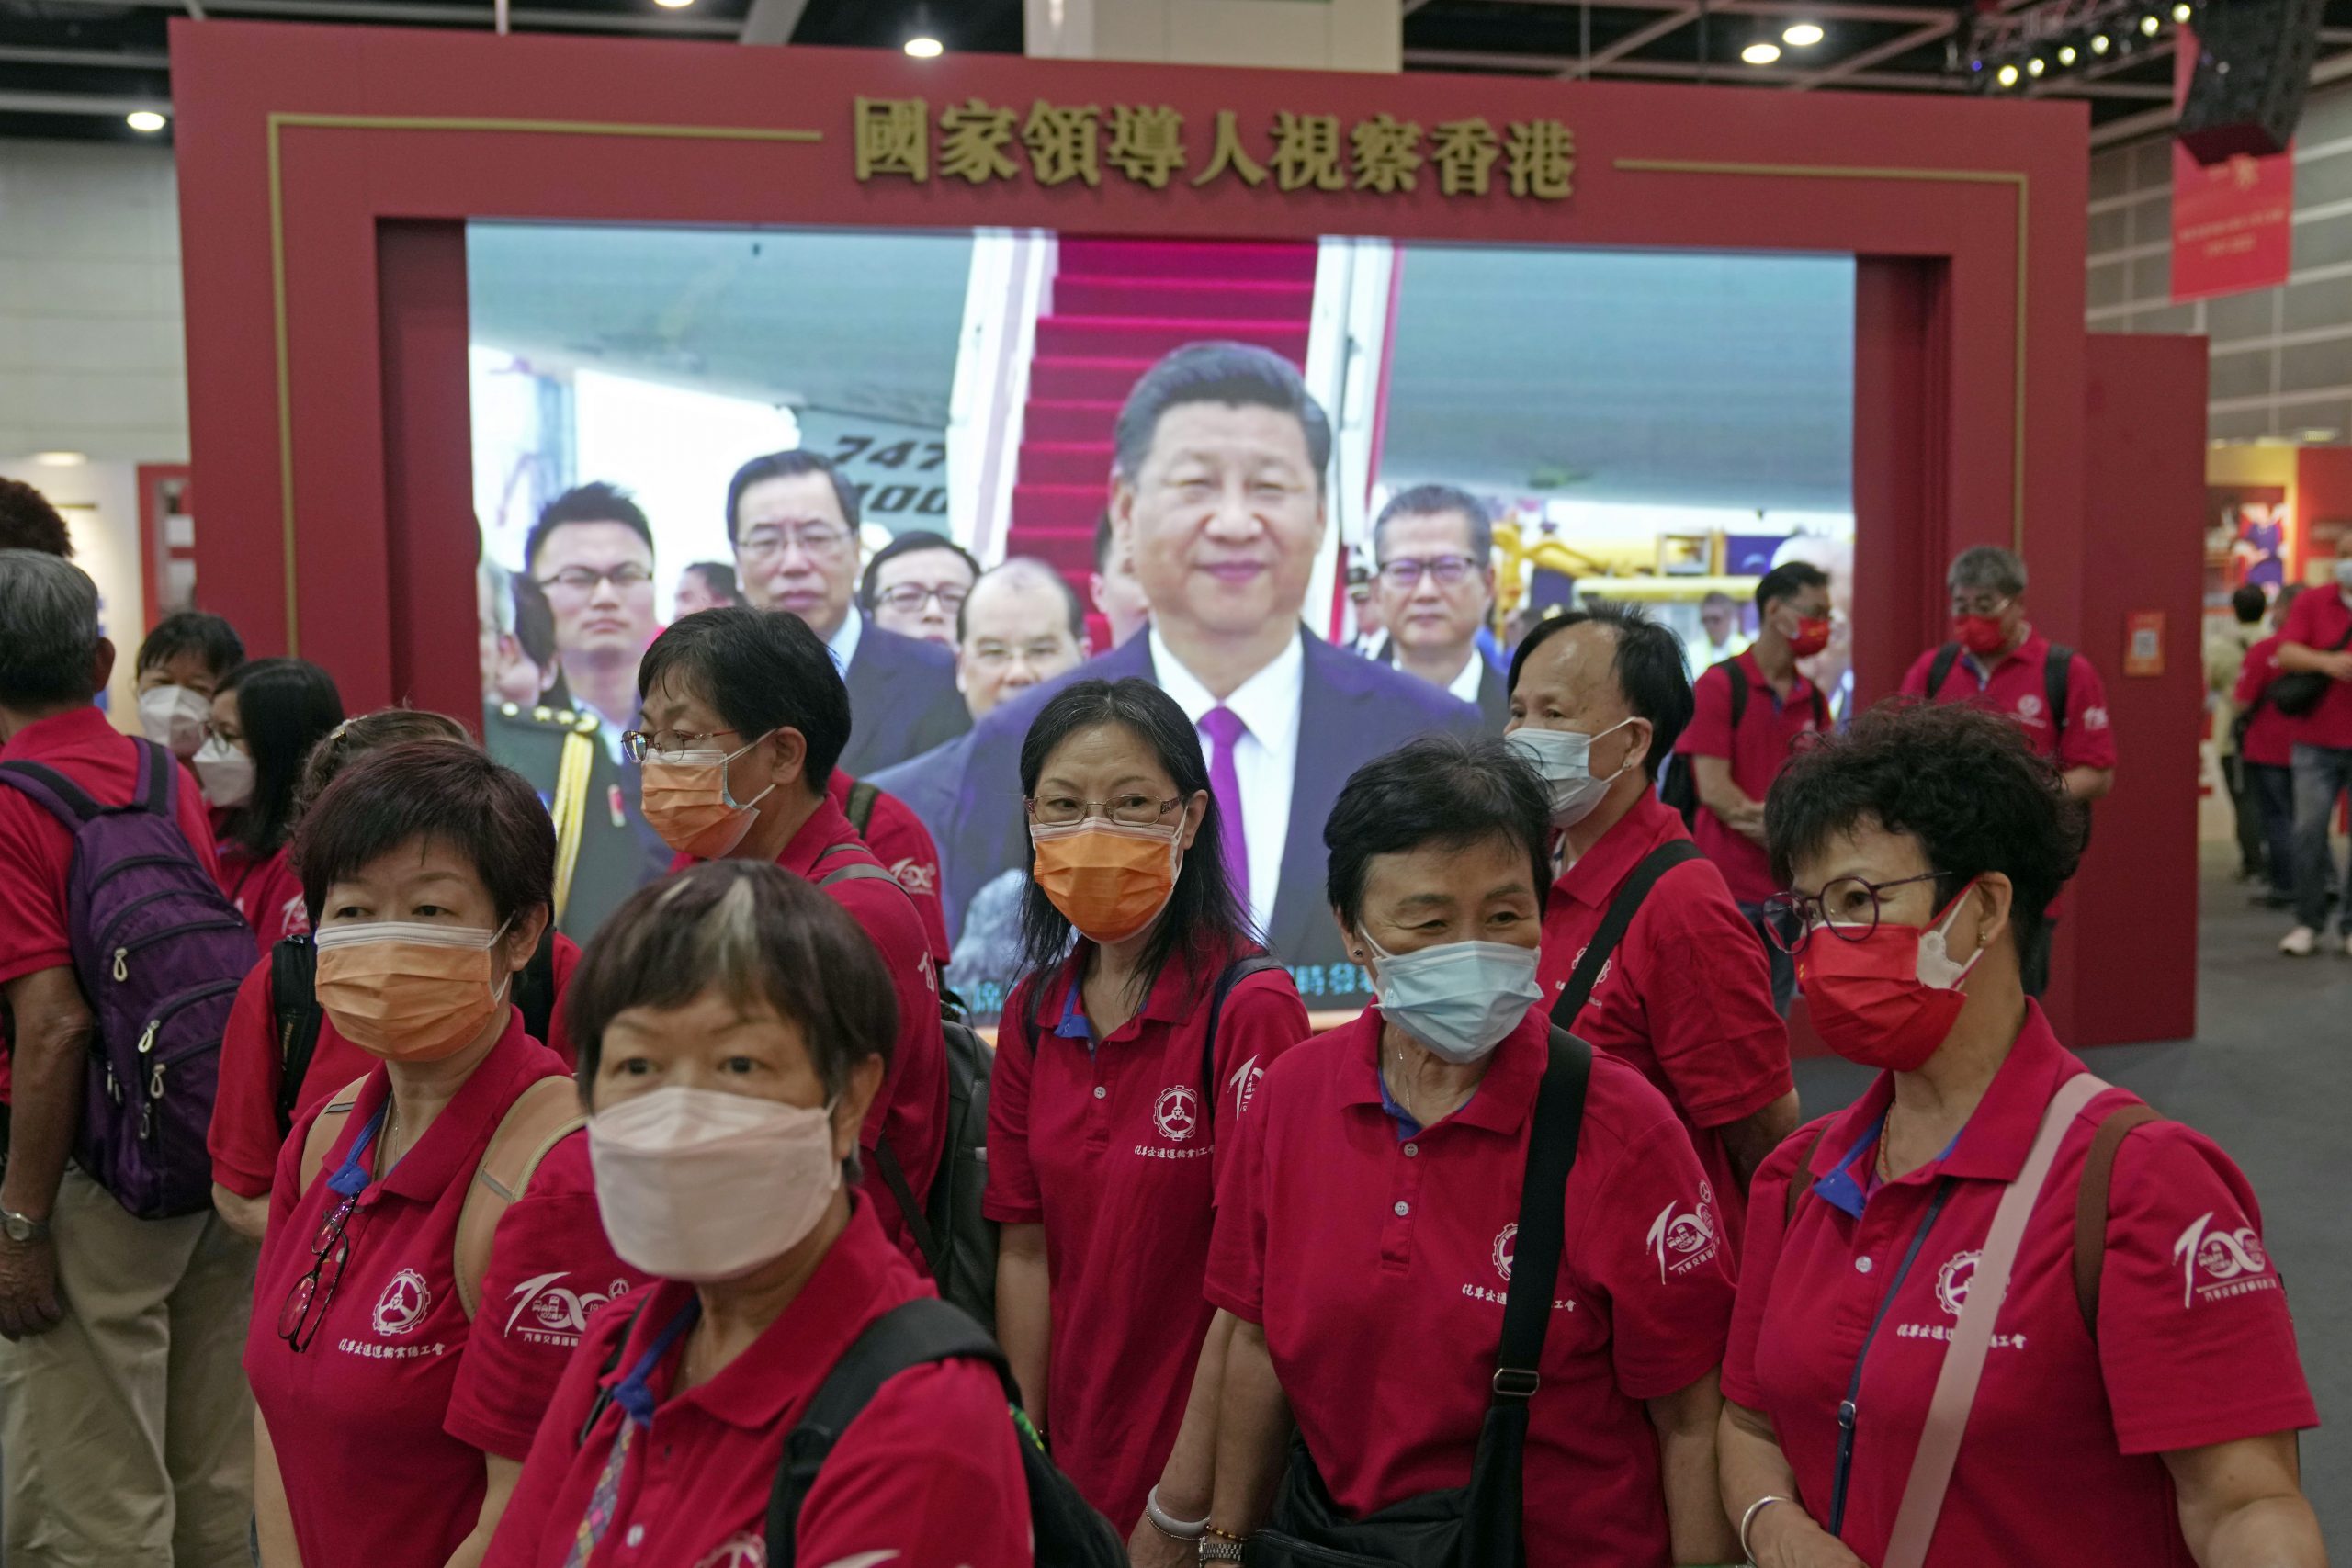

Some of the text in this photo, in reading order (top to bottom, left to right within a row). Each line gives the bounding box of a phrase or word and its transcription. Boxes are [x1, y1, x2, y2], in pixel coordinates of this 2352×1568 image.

[854, 96, 1575, 199] 國家領導人視察香港
[834, 435, 947, 469] 747
